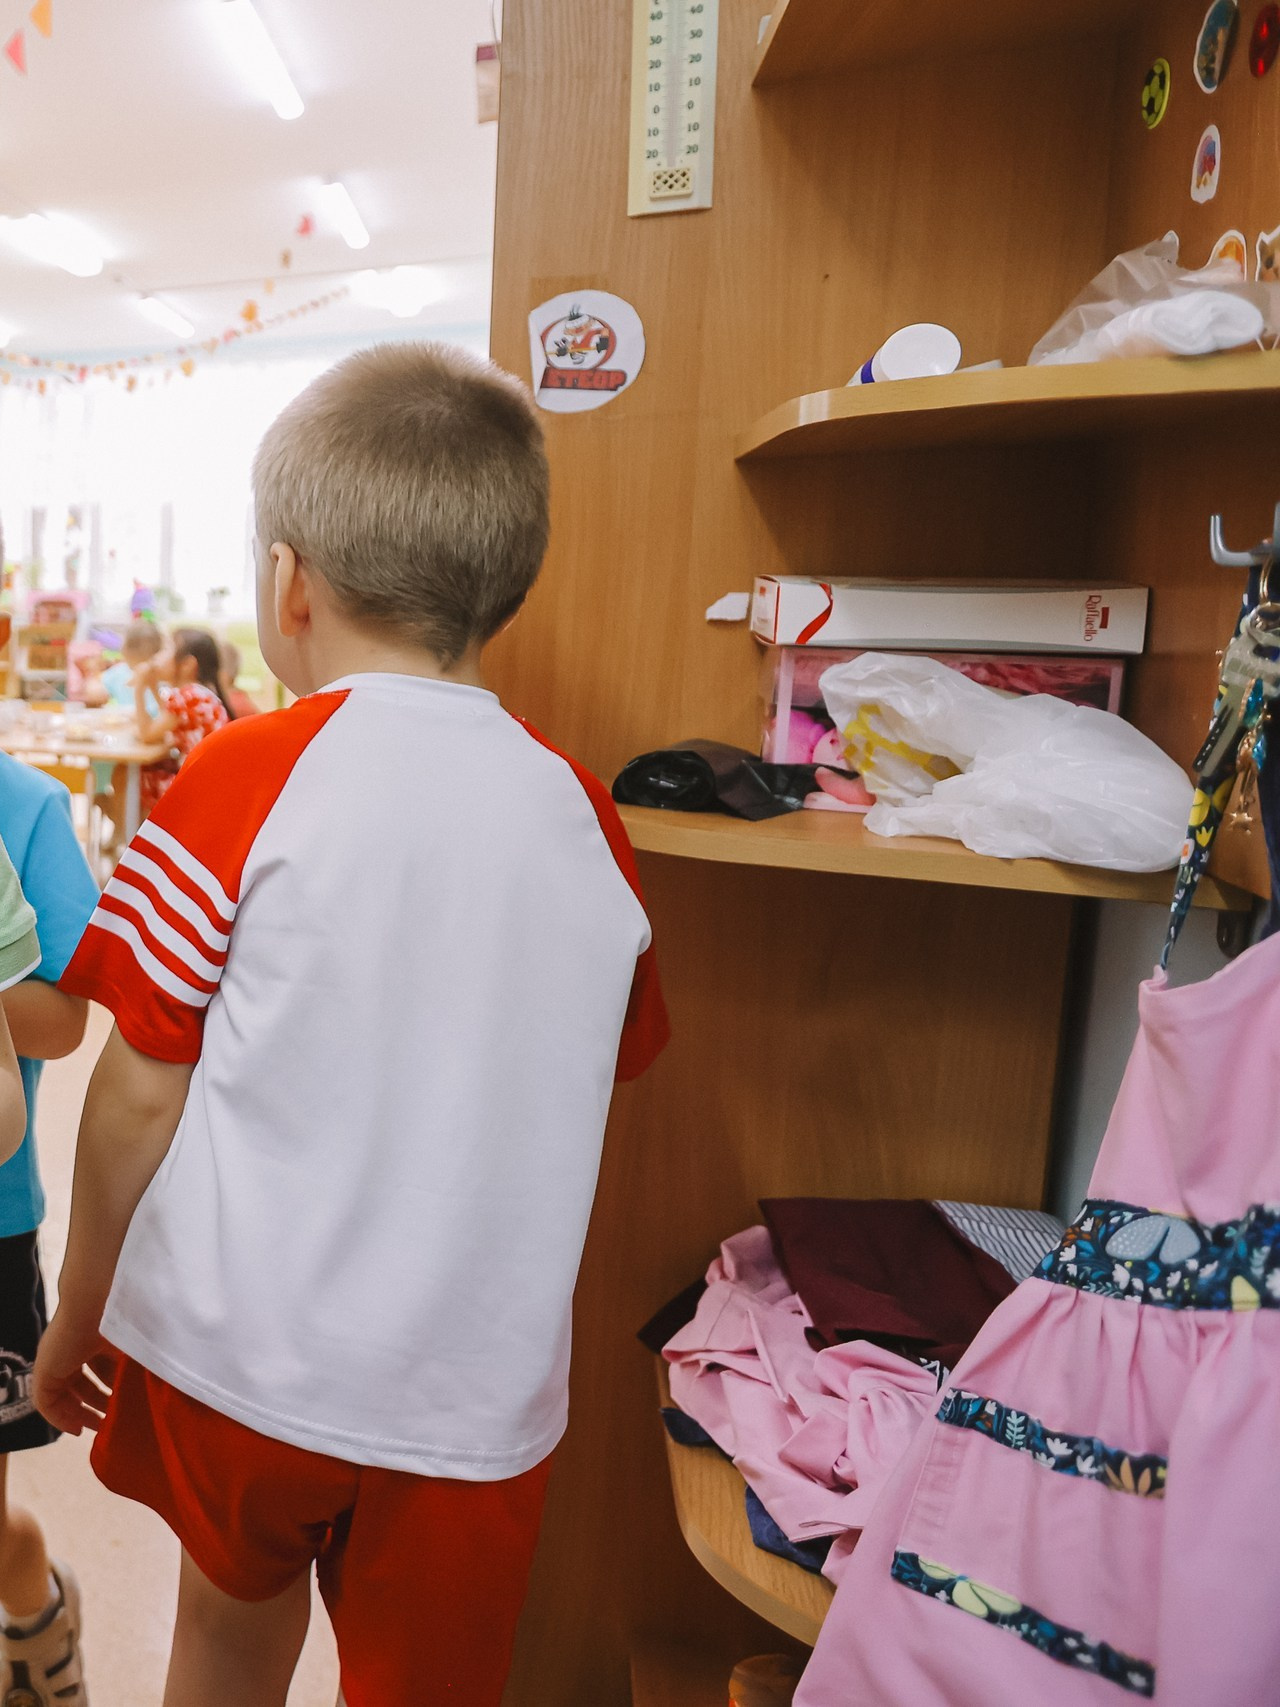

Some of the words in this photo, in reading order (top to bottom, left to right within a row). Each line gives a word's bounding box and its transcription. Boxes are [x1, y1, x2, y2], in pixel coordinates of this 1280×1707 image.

[689, 53, 702, 63] 20
[649, 59, 661, 70] 20
[689, 77, 701, 86] 10
[649, 83, 660, 92] 10
[653, 105, 660, 114] 0
[687, 100, 695, 110] 0
[687, 122, 700, 132] 10
[647, 127, 659, 138] 10
[646, 149, 658, 160] 20
[686, 144, 699, 155] 20
[1083, 594, 1102, 642] Raffaello
